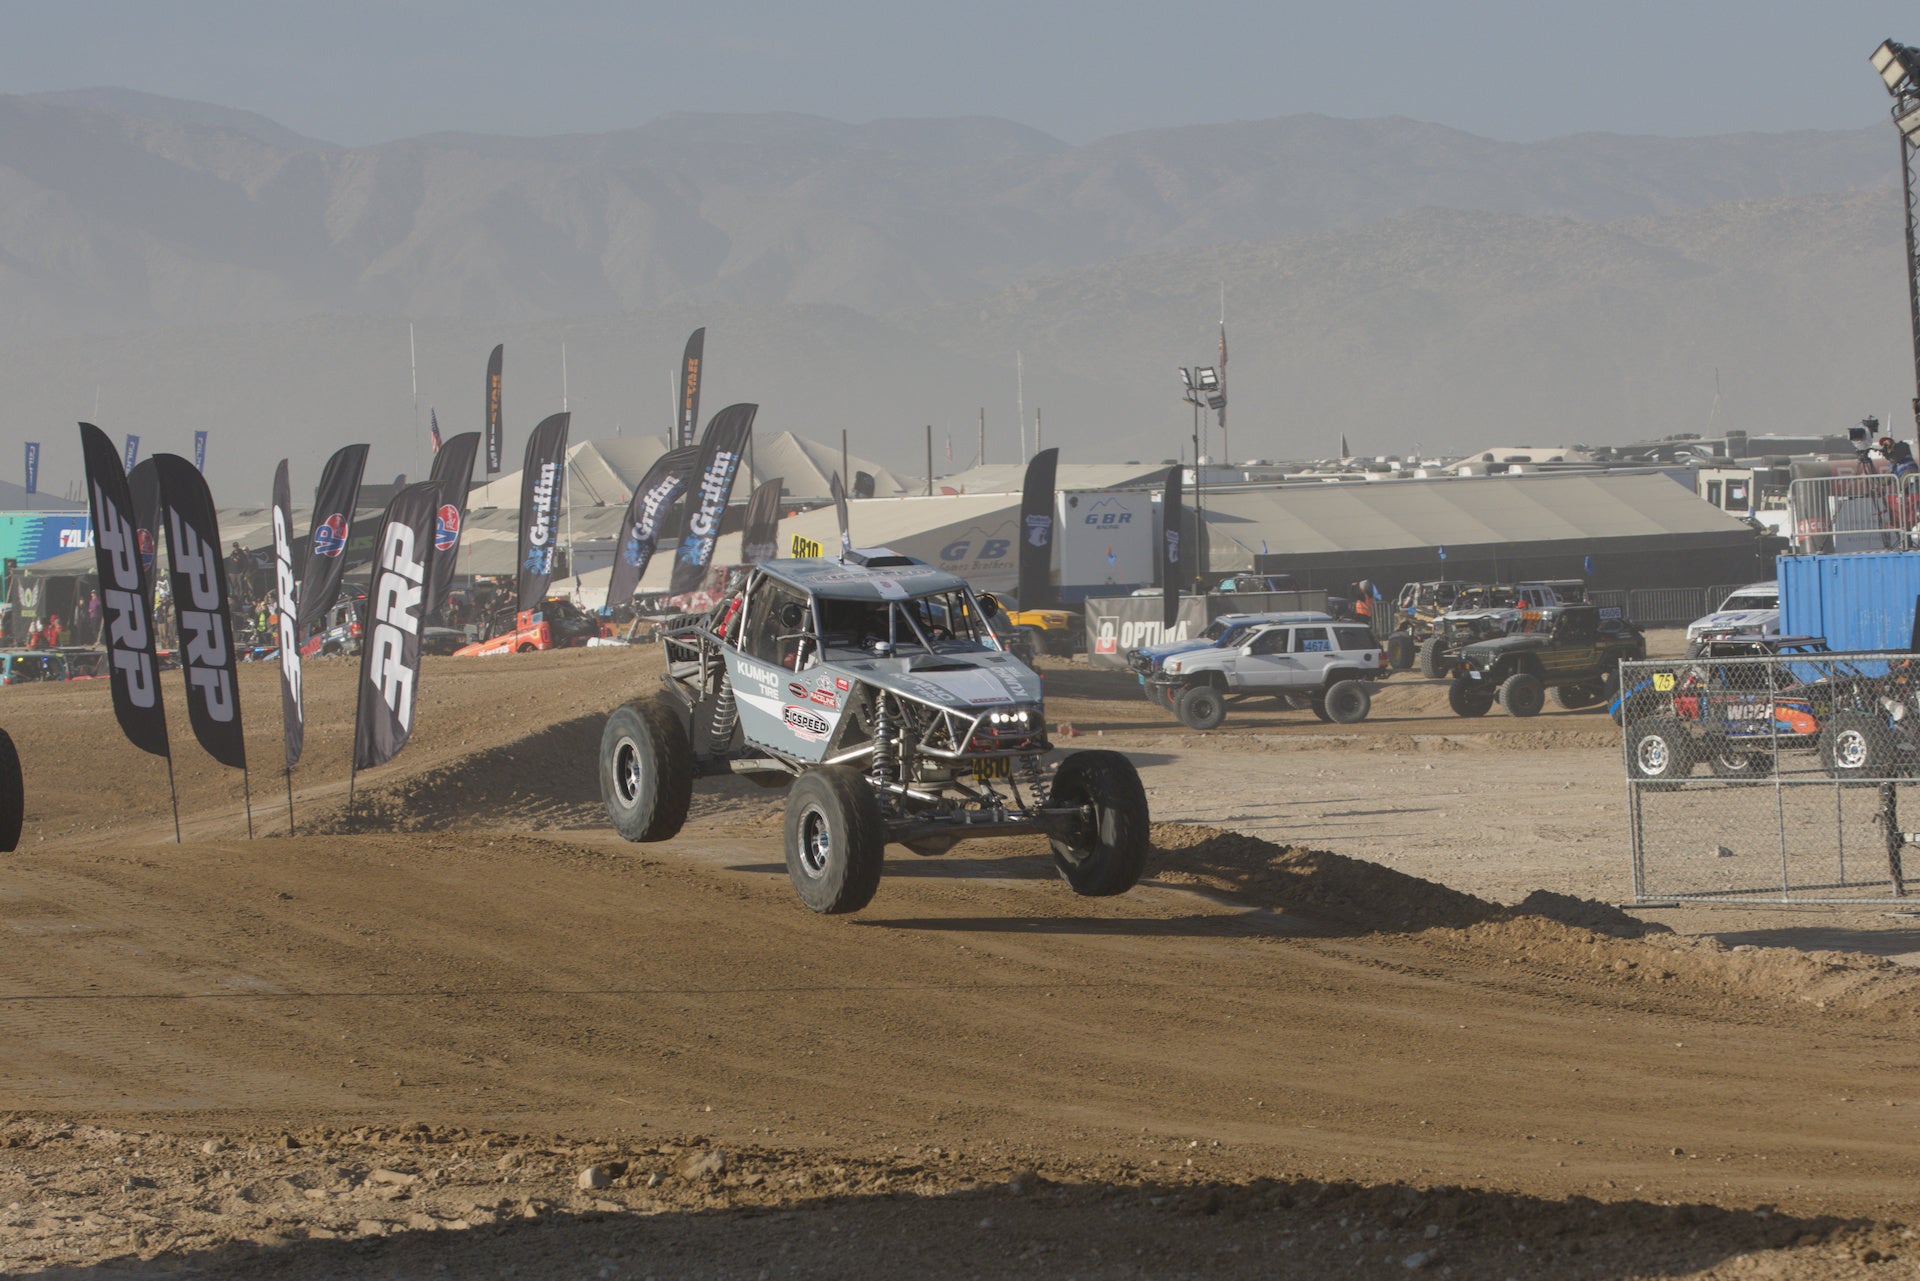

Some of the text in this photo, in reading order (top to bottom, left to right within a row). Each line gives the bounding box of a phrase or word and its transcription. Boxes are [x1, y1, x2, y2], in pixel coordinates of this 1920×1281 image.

[530, 462, 555, 546] Griffin
[690, 451, 732, 535] Griffin
[632, 475, 680, 541] Griffin
[1085, 513, 1132, 525] GBR
[314, 524, 346, 555] VP
[792, 535, 819, 559] 4810
[370, 521, 426, 733] PRP
[1121, 621, 1188, 648] OPTIMA
[1305, 641, 1330, 651] 4674
[737, 661, 779, 687] KUMHO
[758, 682, 779, 700] TIRE
[784, 708, 827, 732] FIGSPEED
